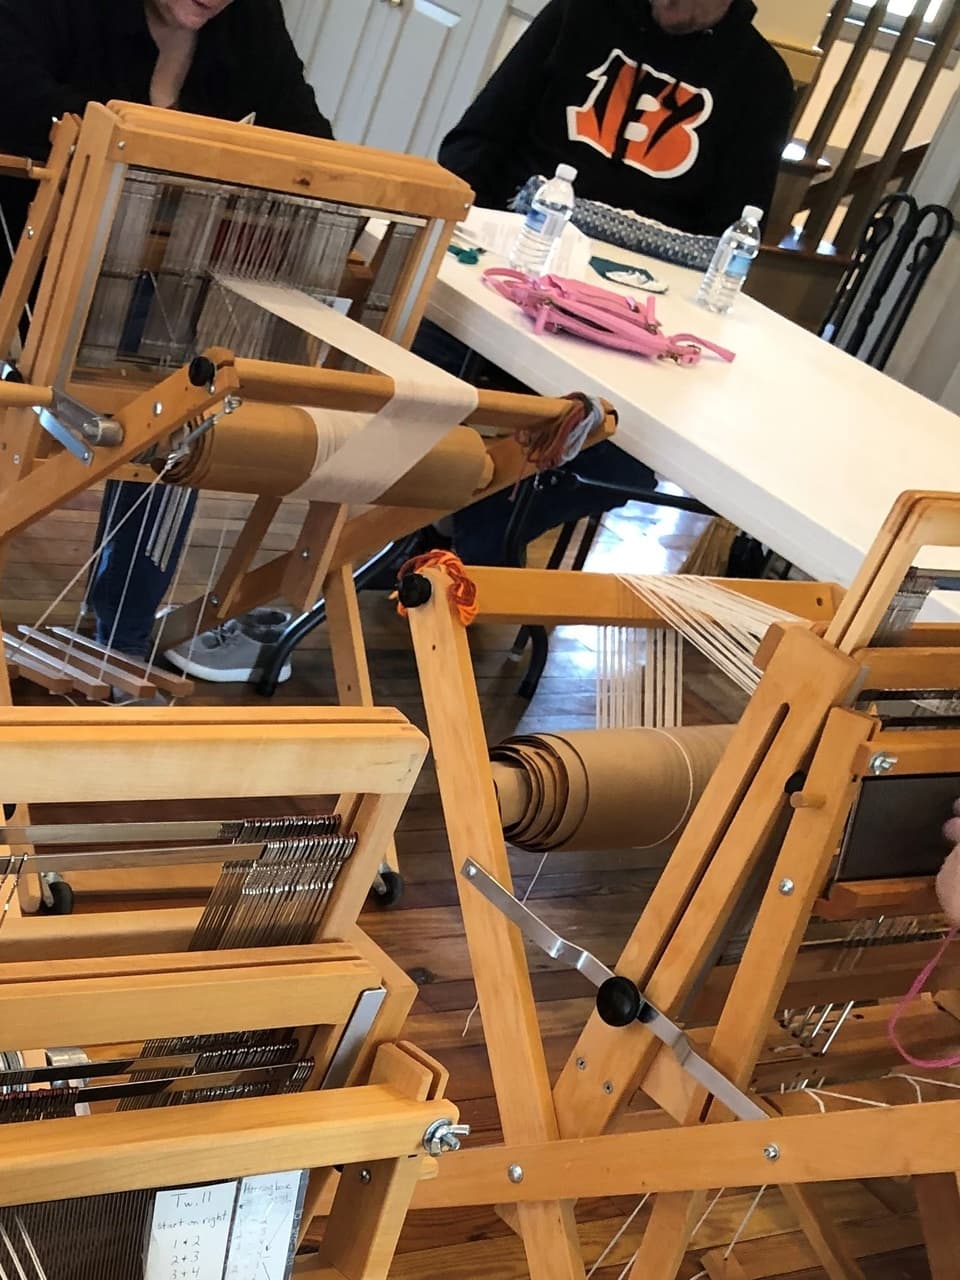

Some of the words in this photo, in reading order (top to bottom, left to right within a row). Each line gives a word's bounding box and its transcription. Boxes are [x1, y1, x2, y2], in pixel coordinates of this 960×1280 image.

[202, 1210, 227, 1228] right
[173, 1239, 178, 1249] 1
[193, 1235, 200, 1246] 2
[171, 1255, 179, 1265] 2
[193, 1250, 200, 1262] 3
[171, 1269, 177, 1280] 3
[192, 1267, 200, 1278] 4
